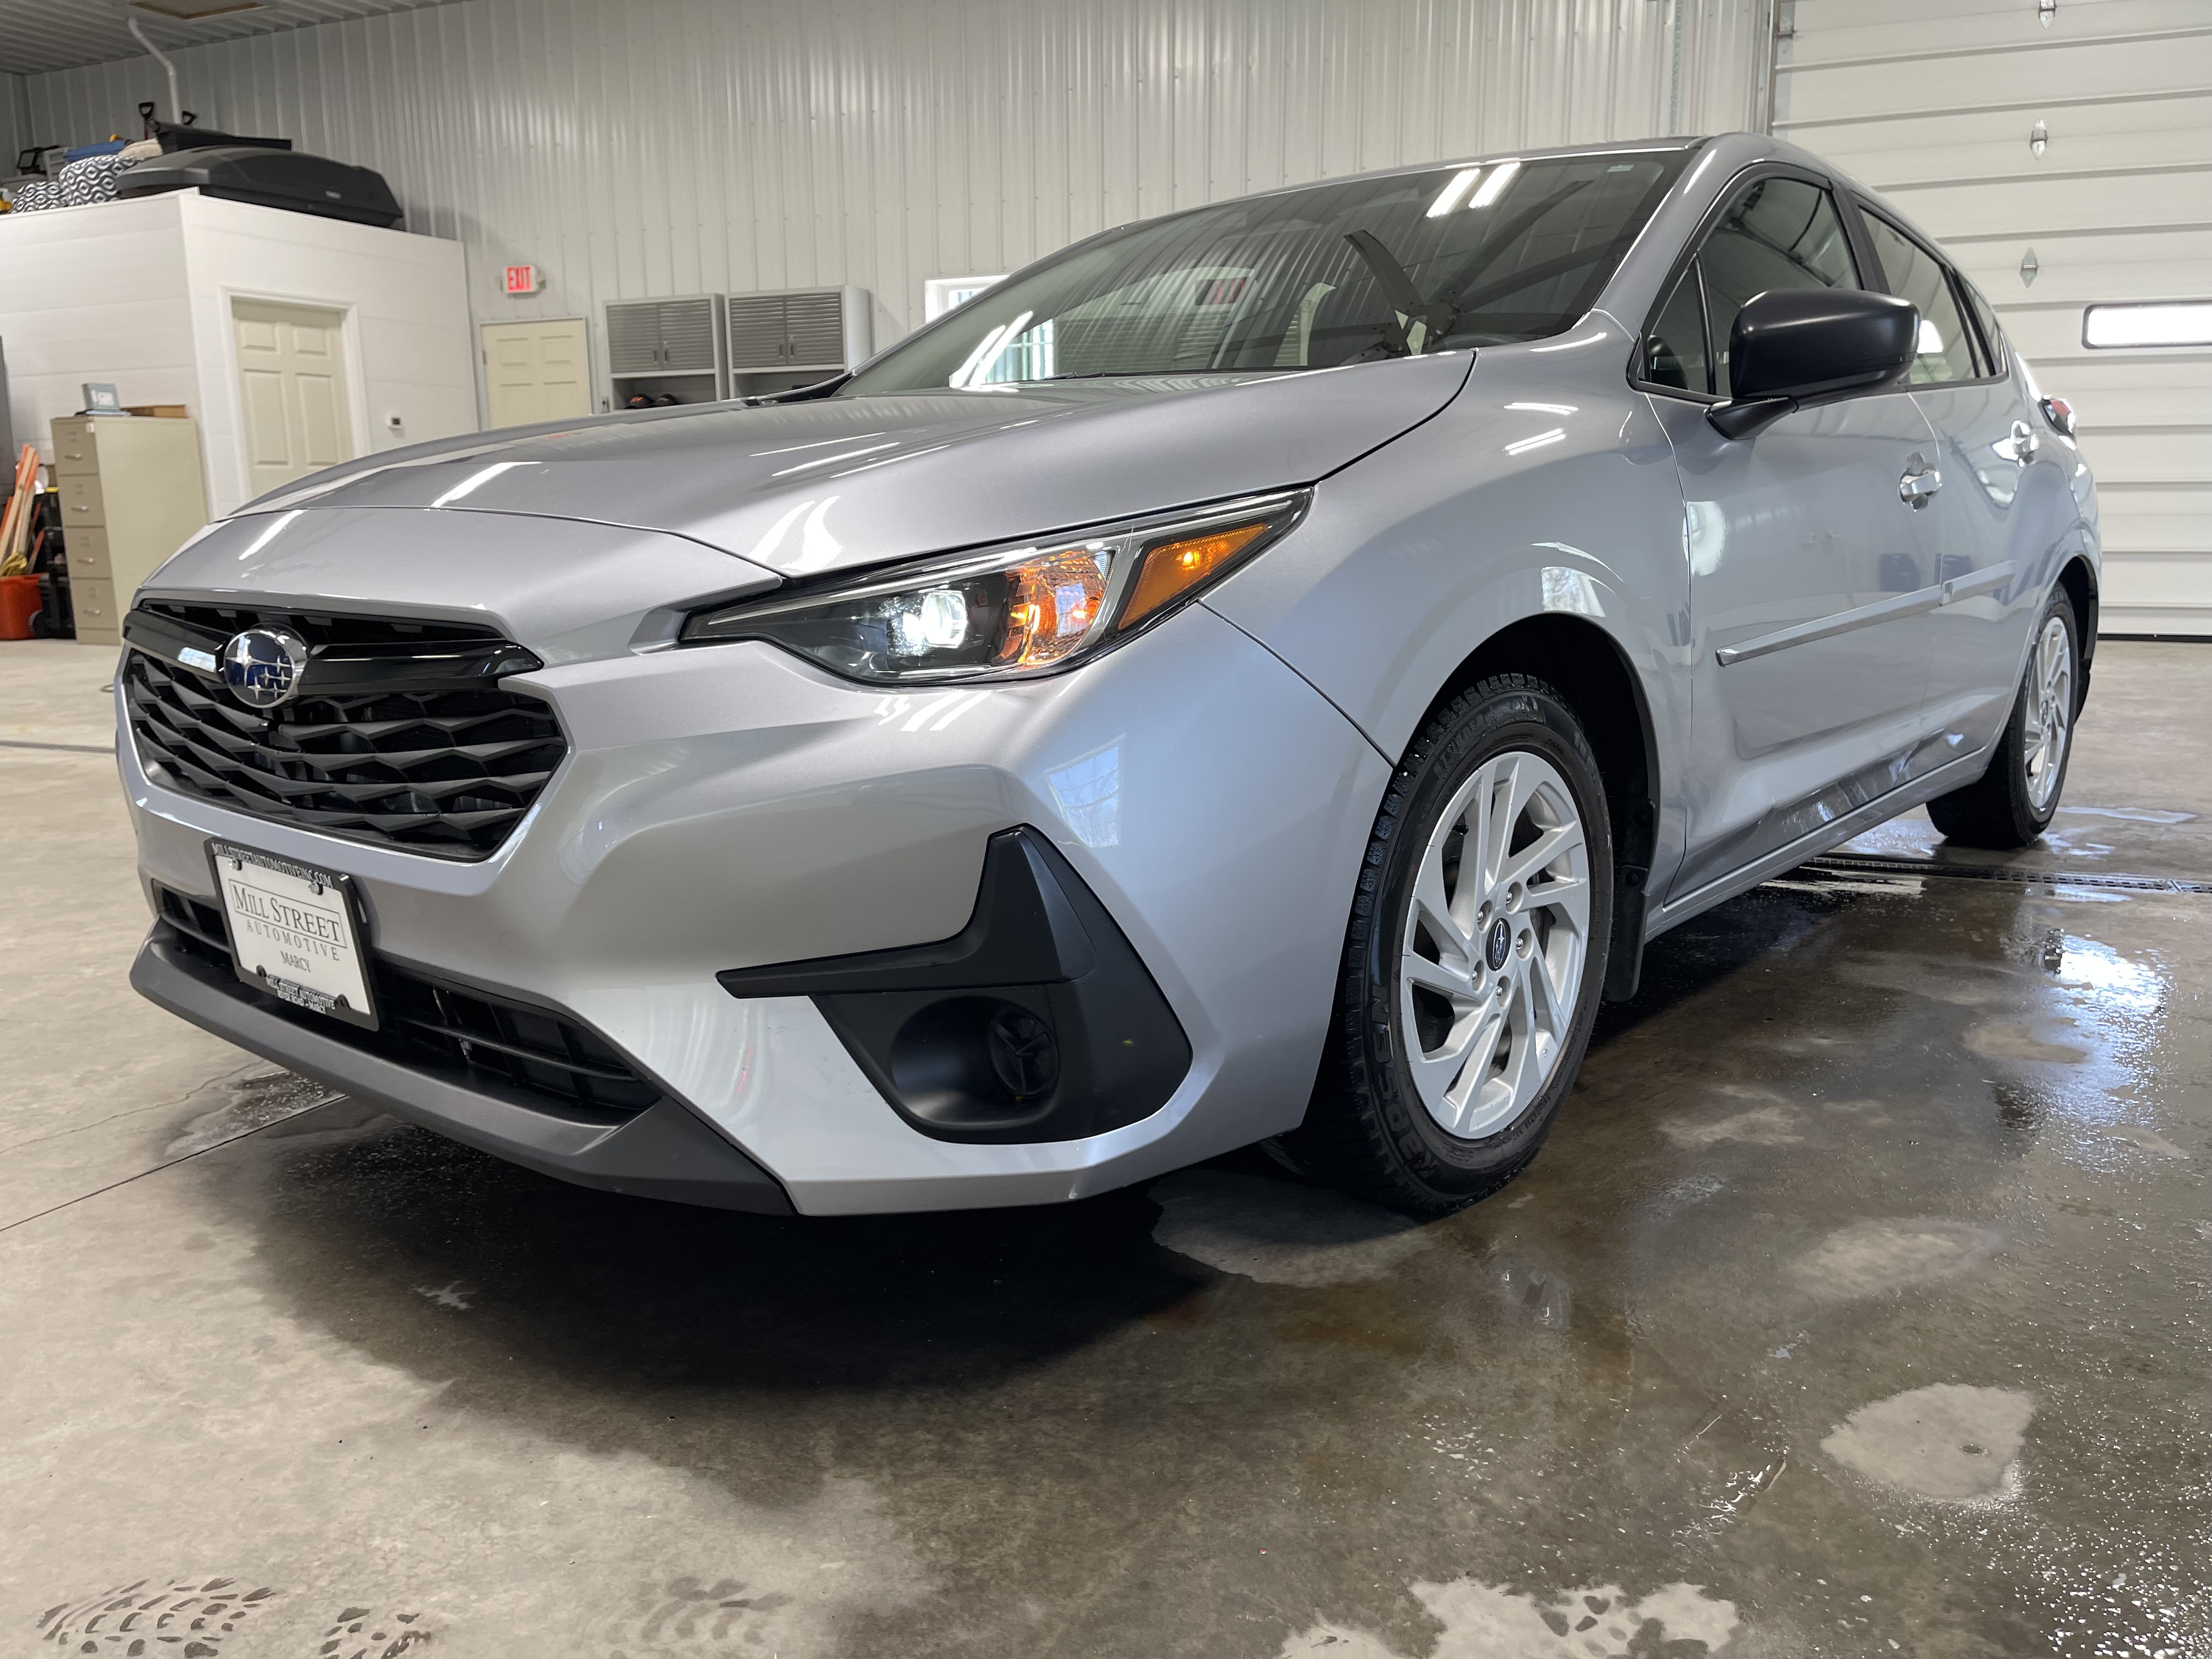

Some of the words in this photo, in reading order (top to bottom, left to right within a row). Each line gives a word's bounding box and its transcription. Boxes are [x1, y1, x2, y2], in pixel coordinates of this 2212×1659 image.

[507, 266, 531, 291] EXIT
[233, 884, 269, 919] MILL
[270, 898, 340, 942] STREET
[246, 919, 339, 961] AUTOMOTIVE
[280, 951, 312, 973] MARCY
